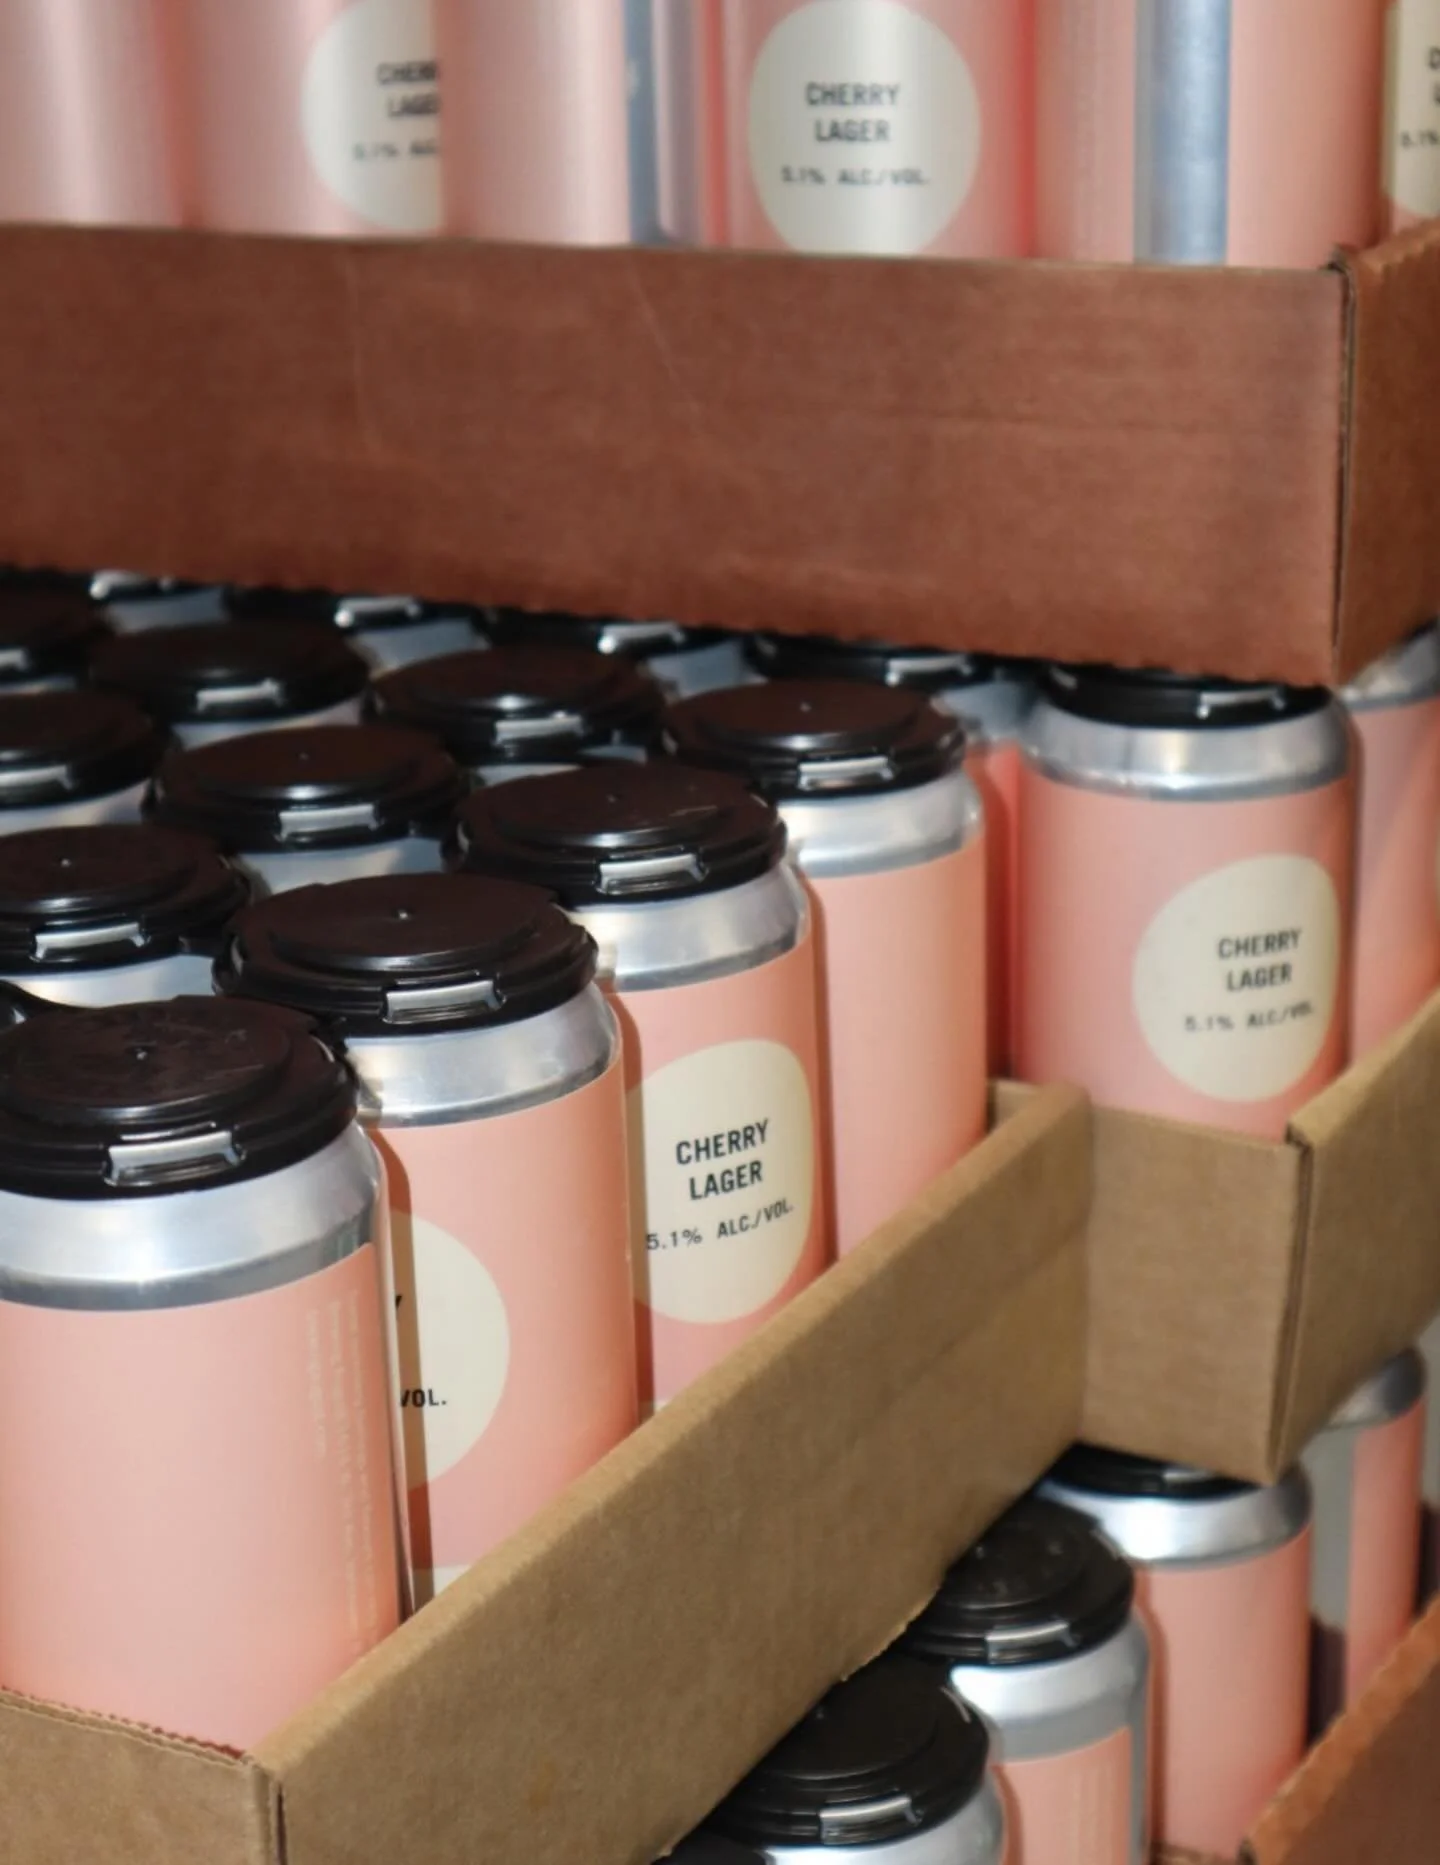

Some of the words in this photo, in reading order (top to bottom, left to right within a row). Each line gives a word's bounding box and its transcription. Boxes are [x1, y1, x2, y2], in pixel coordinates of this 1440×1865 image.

[805, 81, 901, 106] CHERRY
[815, 119, 890, 142] LAGER
[1217, 928, 1303, 960] CHERRY
[1226, 962, 1293, 993] LAGER
[674, 1117, 770, 1166] CHERRY
[688, 1159, 764, 1201] LAGER
[645, 1226, 703, 1250] 5.1%
[716, 1197, 794, 1239] ALC./VOL.
